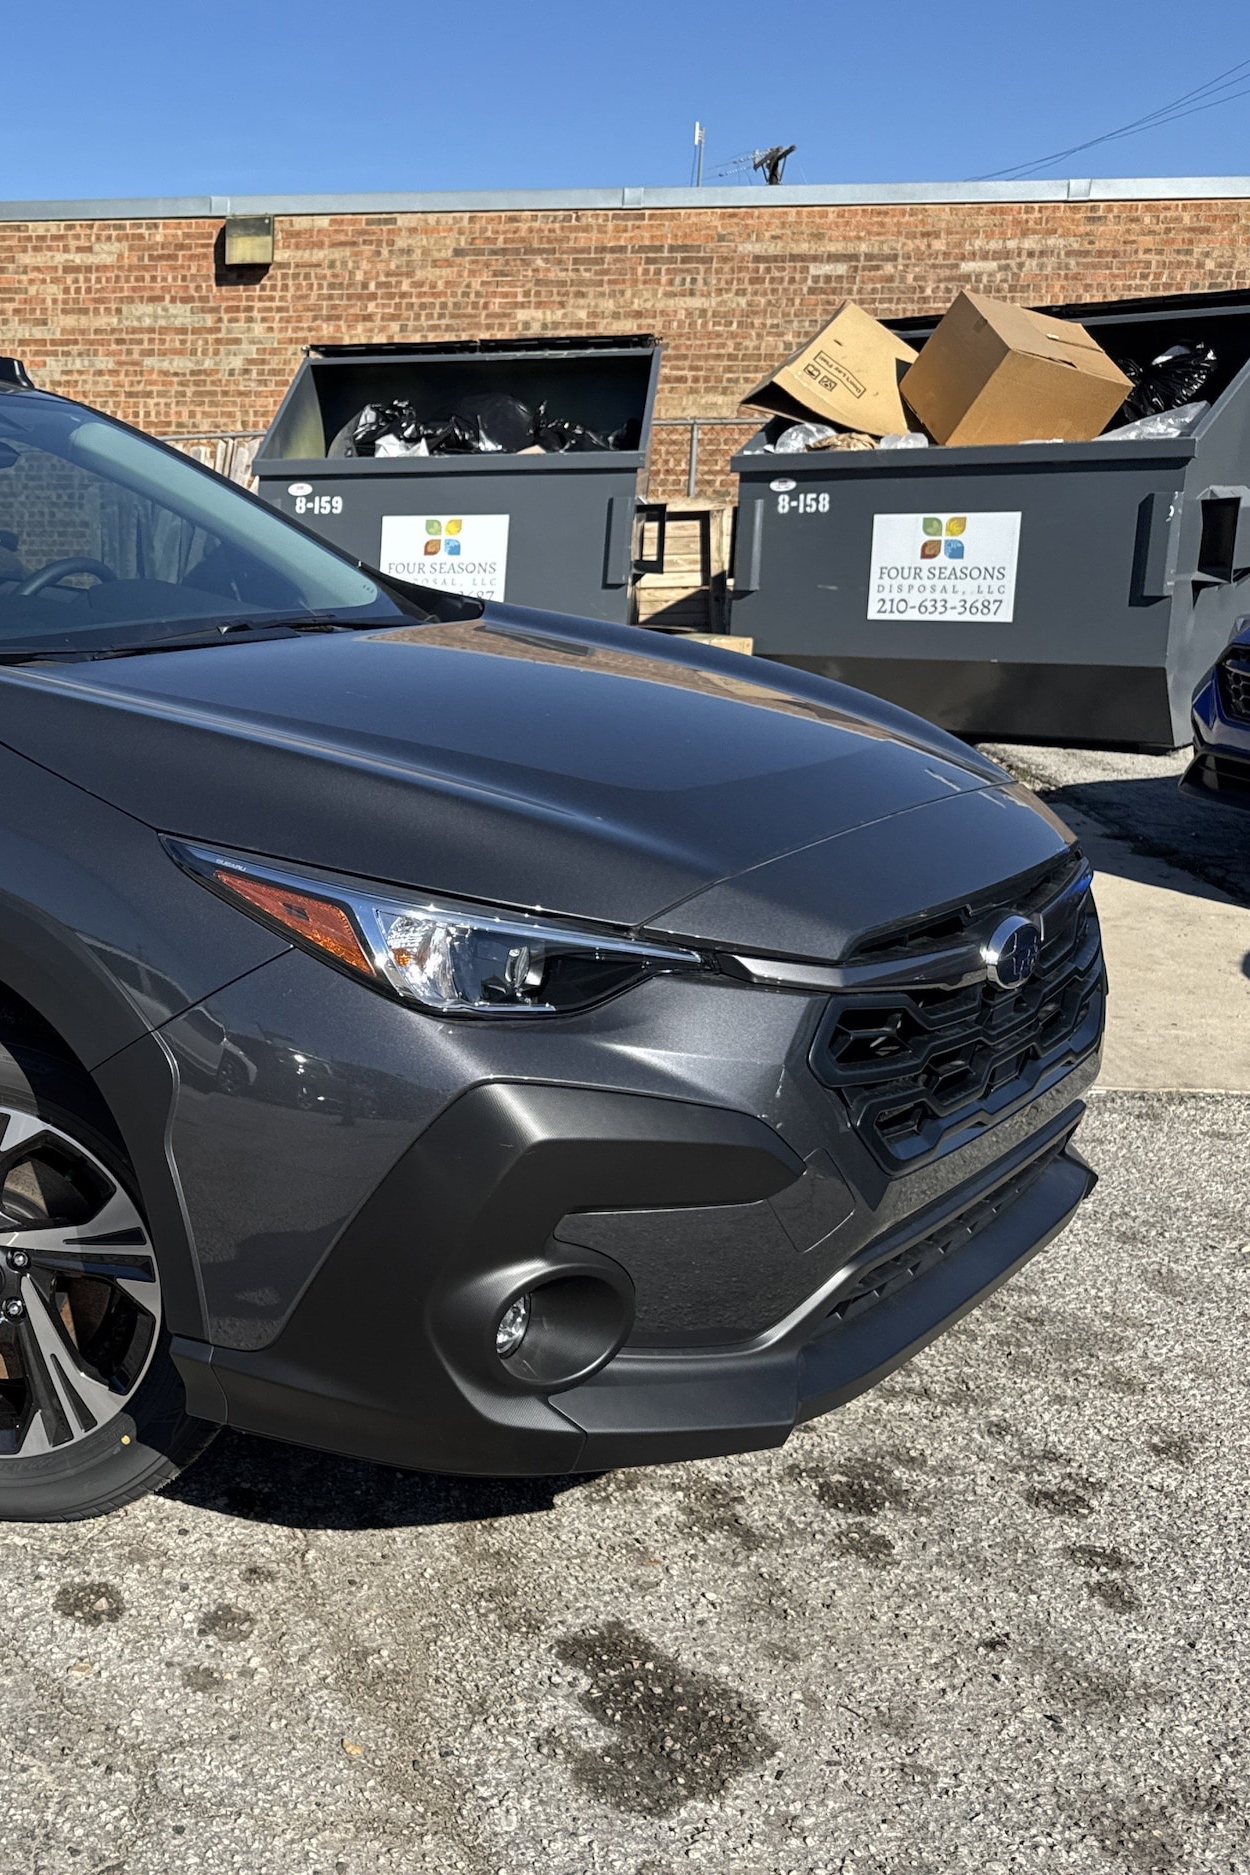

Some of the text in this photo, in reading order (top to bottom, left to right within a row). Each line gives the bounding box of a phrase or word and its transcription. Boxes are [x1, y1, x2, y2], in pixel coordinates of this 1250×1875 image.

[295, 495, 343, 515] 8-159
[777, 492, 830, 514] 8-158
[388, 561, 497, 575] FOUR SEASONS
[878, 566, 1007, 581] FOUR SEASONS
[472, 577, 497, 586] LLC
[876, 583, 1006, 595] DISPOSAL, LLC
[876, 598, 1004, 617] 210-633-3687
